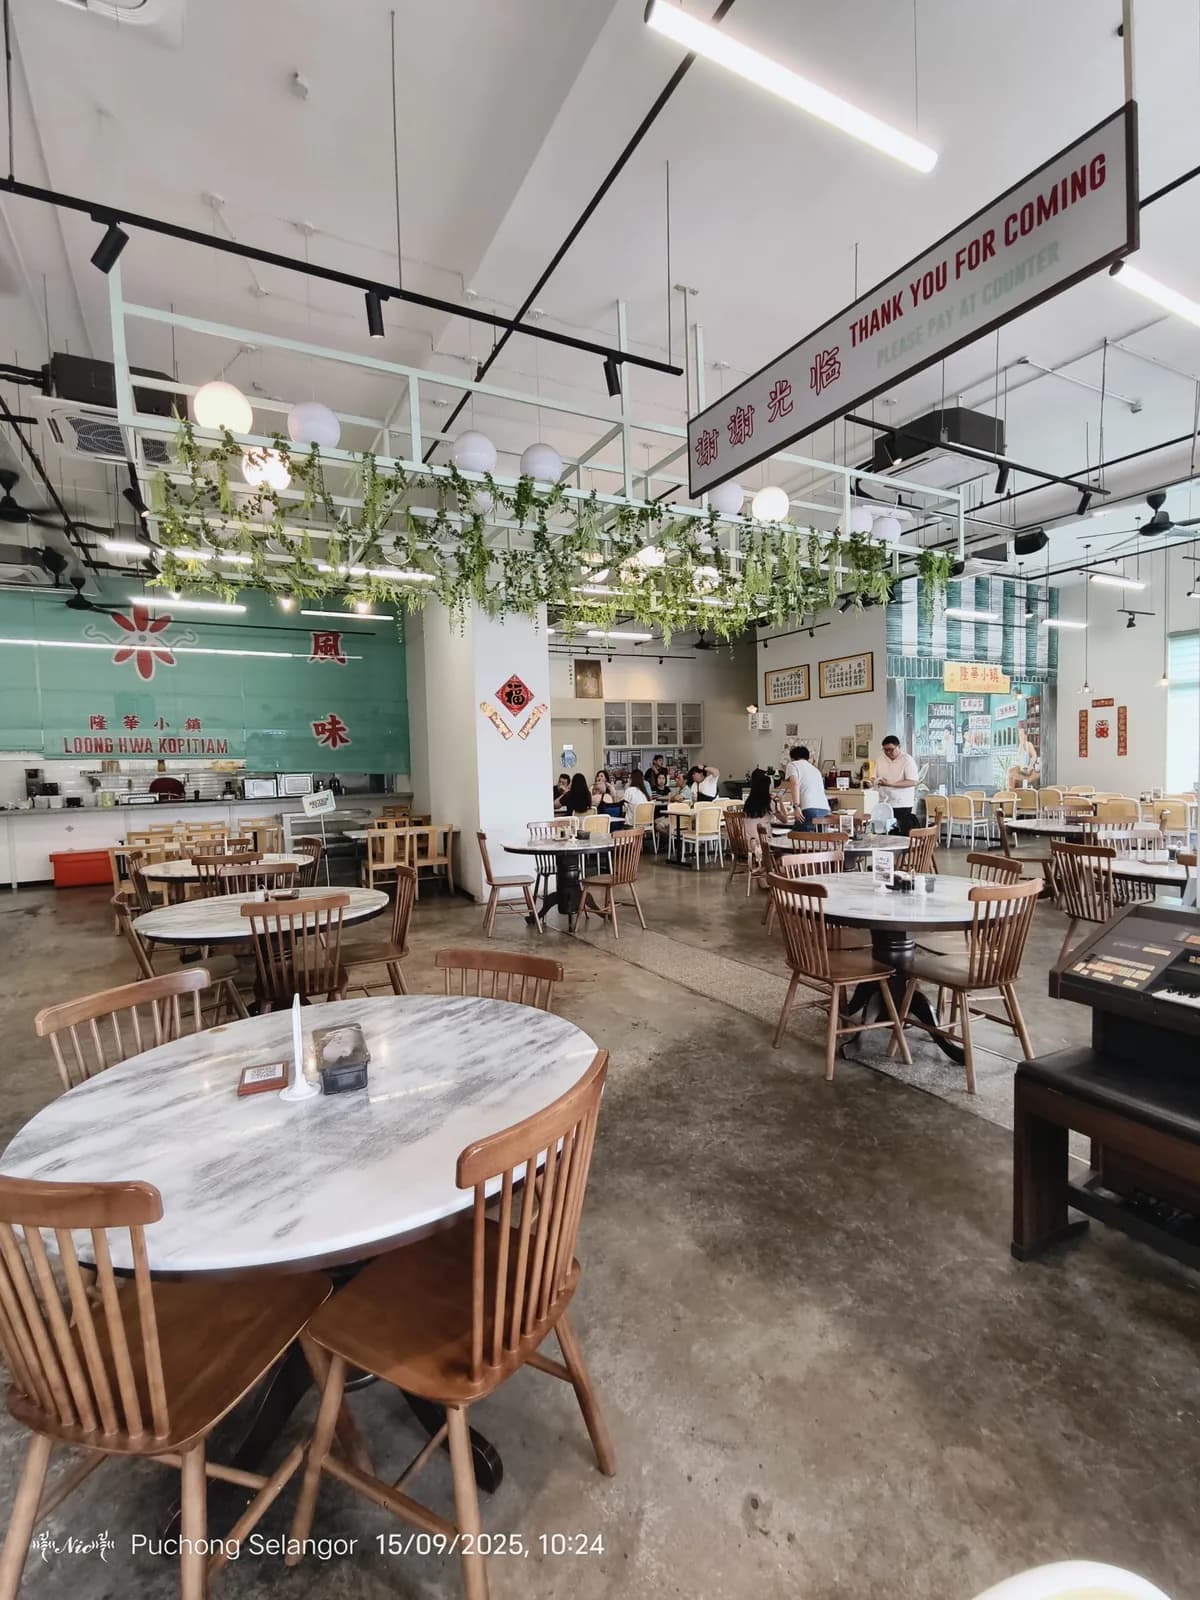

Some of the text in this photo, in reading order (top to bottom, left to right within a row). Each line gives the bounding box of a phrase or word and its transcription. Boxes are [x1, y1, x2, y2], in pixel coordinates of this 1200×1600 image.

[849, 153, 1107, 348] THANK YOU FOR COMING
[876, 240, 1061, 369] PLEASE PAY AT COUNTER
[695, 346, 842, 467] 谢谢光临
[63, 737, 229, 754] LOONG HWA KOPITIAM
[504, 683, 526, 706] 福
